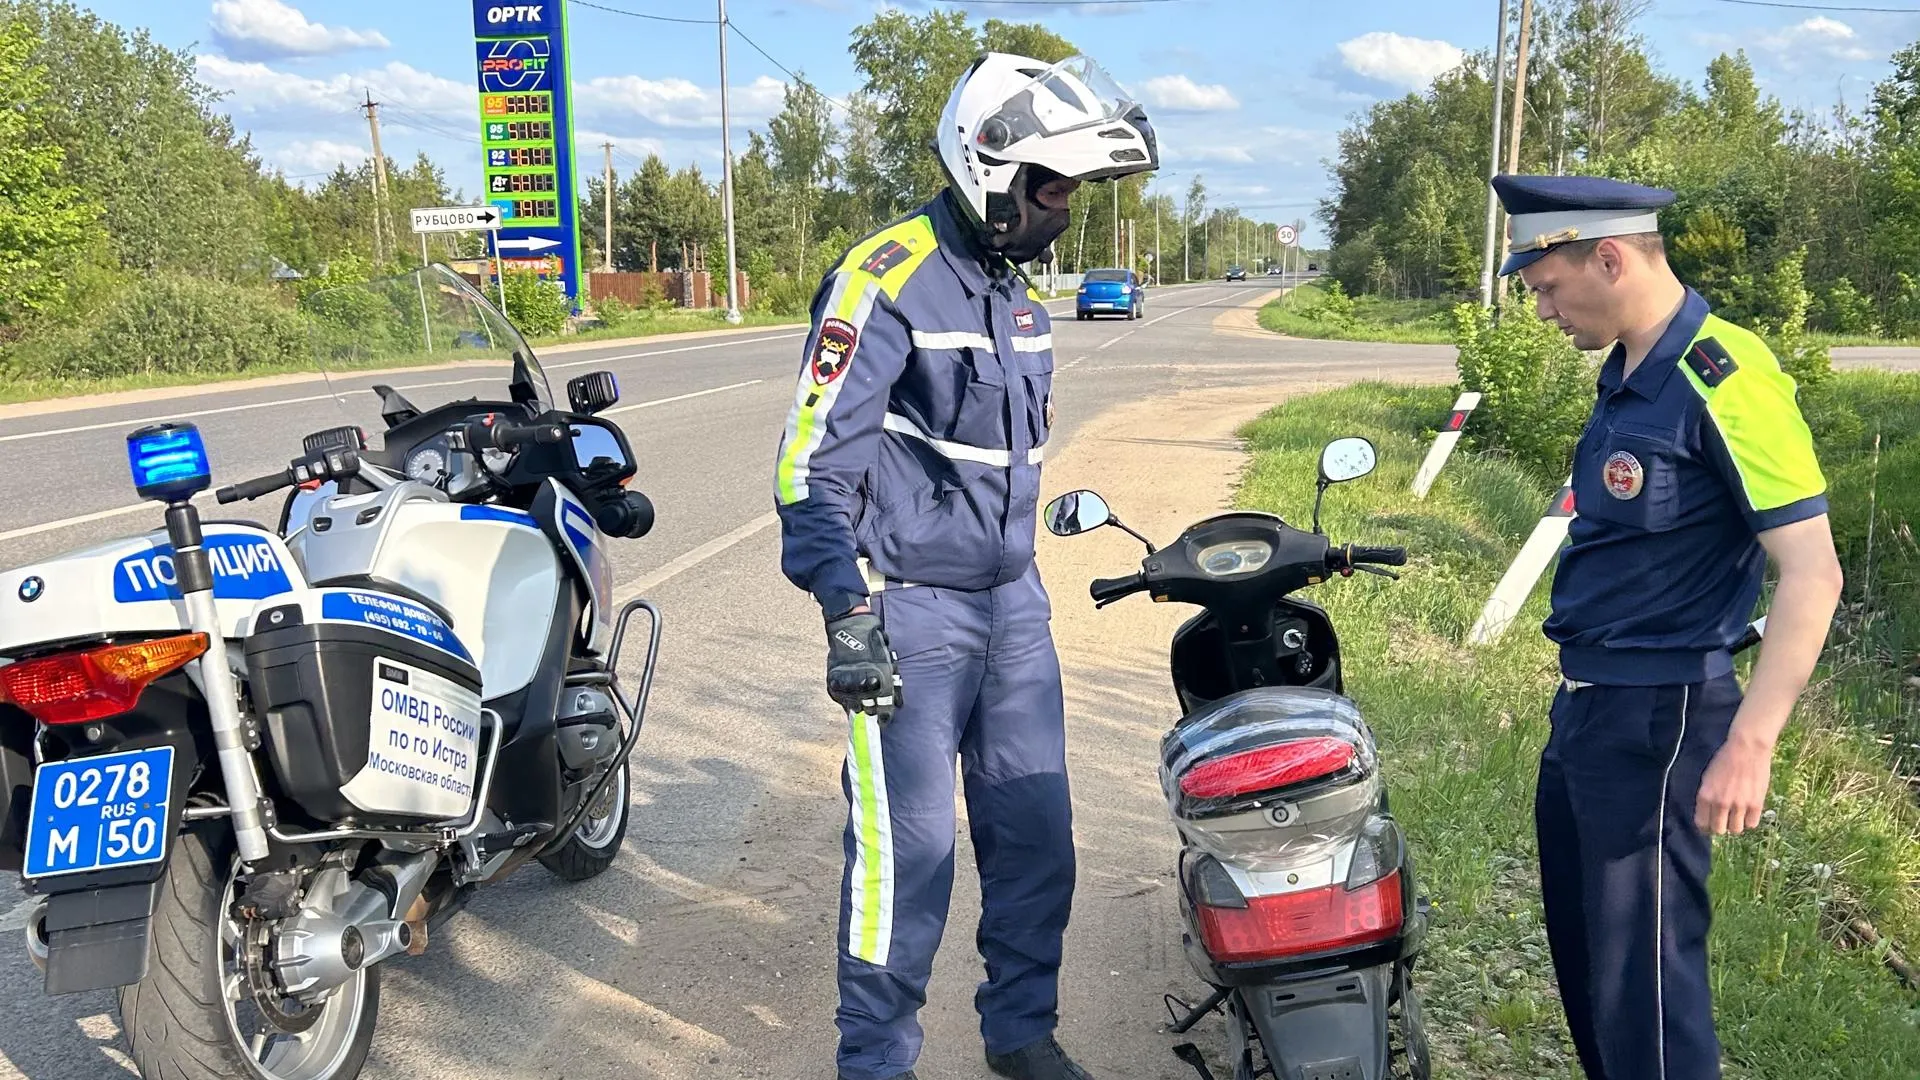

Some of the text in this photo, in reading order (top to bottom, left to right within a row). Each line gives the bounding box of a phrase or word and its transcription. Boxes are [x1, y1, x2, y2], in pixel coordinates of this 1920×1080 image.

[487, 5, 543, 23] ОРТК
[482, 58, 548, 71] PROFIT
[487, 97, 503, 109] 95
[490, 124, 503, 134] 95
[491, 150, 505, 160] 92
[416, 213, 474, 226] РУБЦОВО
[1281, 231, 1292, 239] 50
[123, 543, 279, 592] ПОИЦИЯ
[347, 593, 403, 613] ТЕЛЕФОН
[364, 610, 391, 627] (495)
[381, 688, 475, 742] ОМВД России
[389, 729, 468, 772] по го Истра
[368, 751, 438, 786] Московская
[54, 761, 150, 809] 0278
[101, 802, 136, 819] RUS
[106, 816, 156, 858] 50
